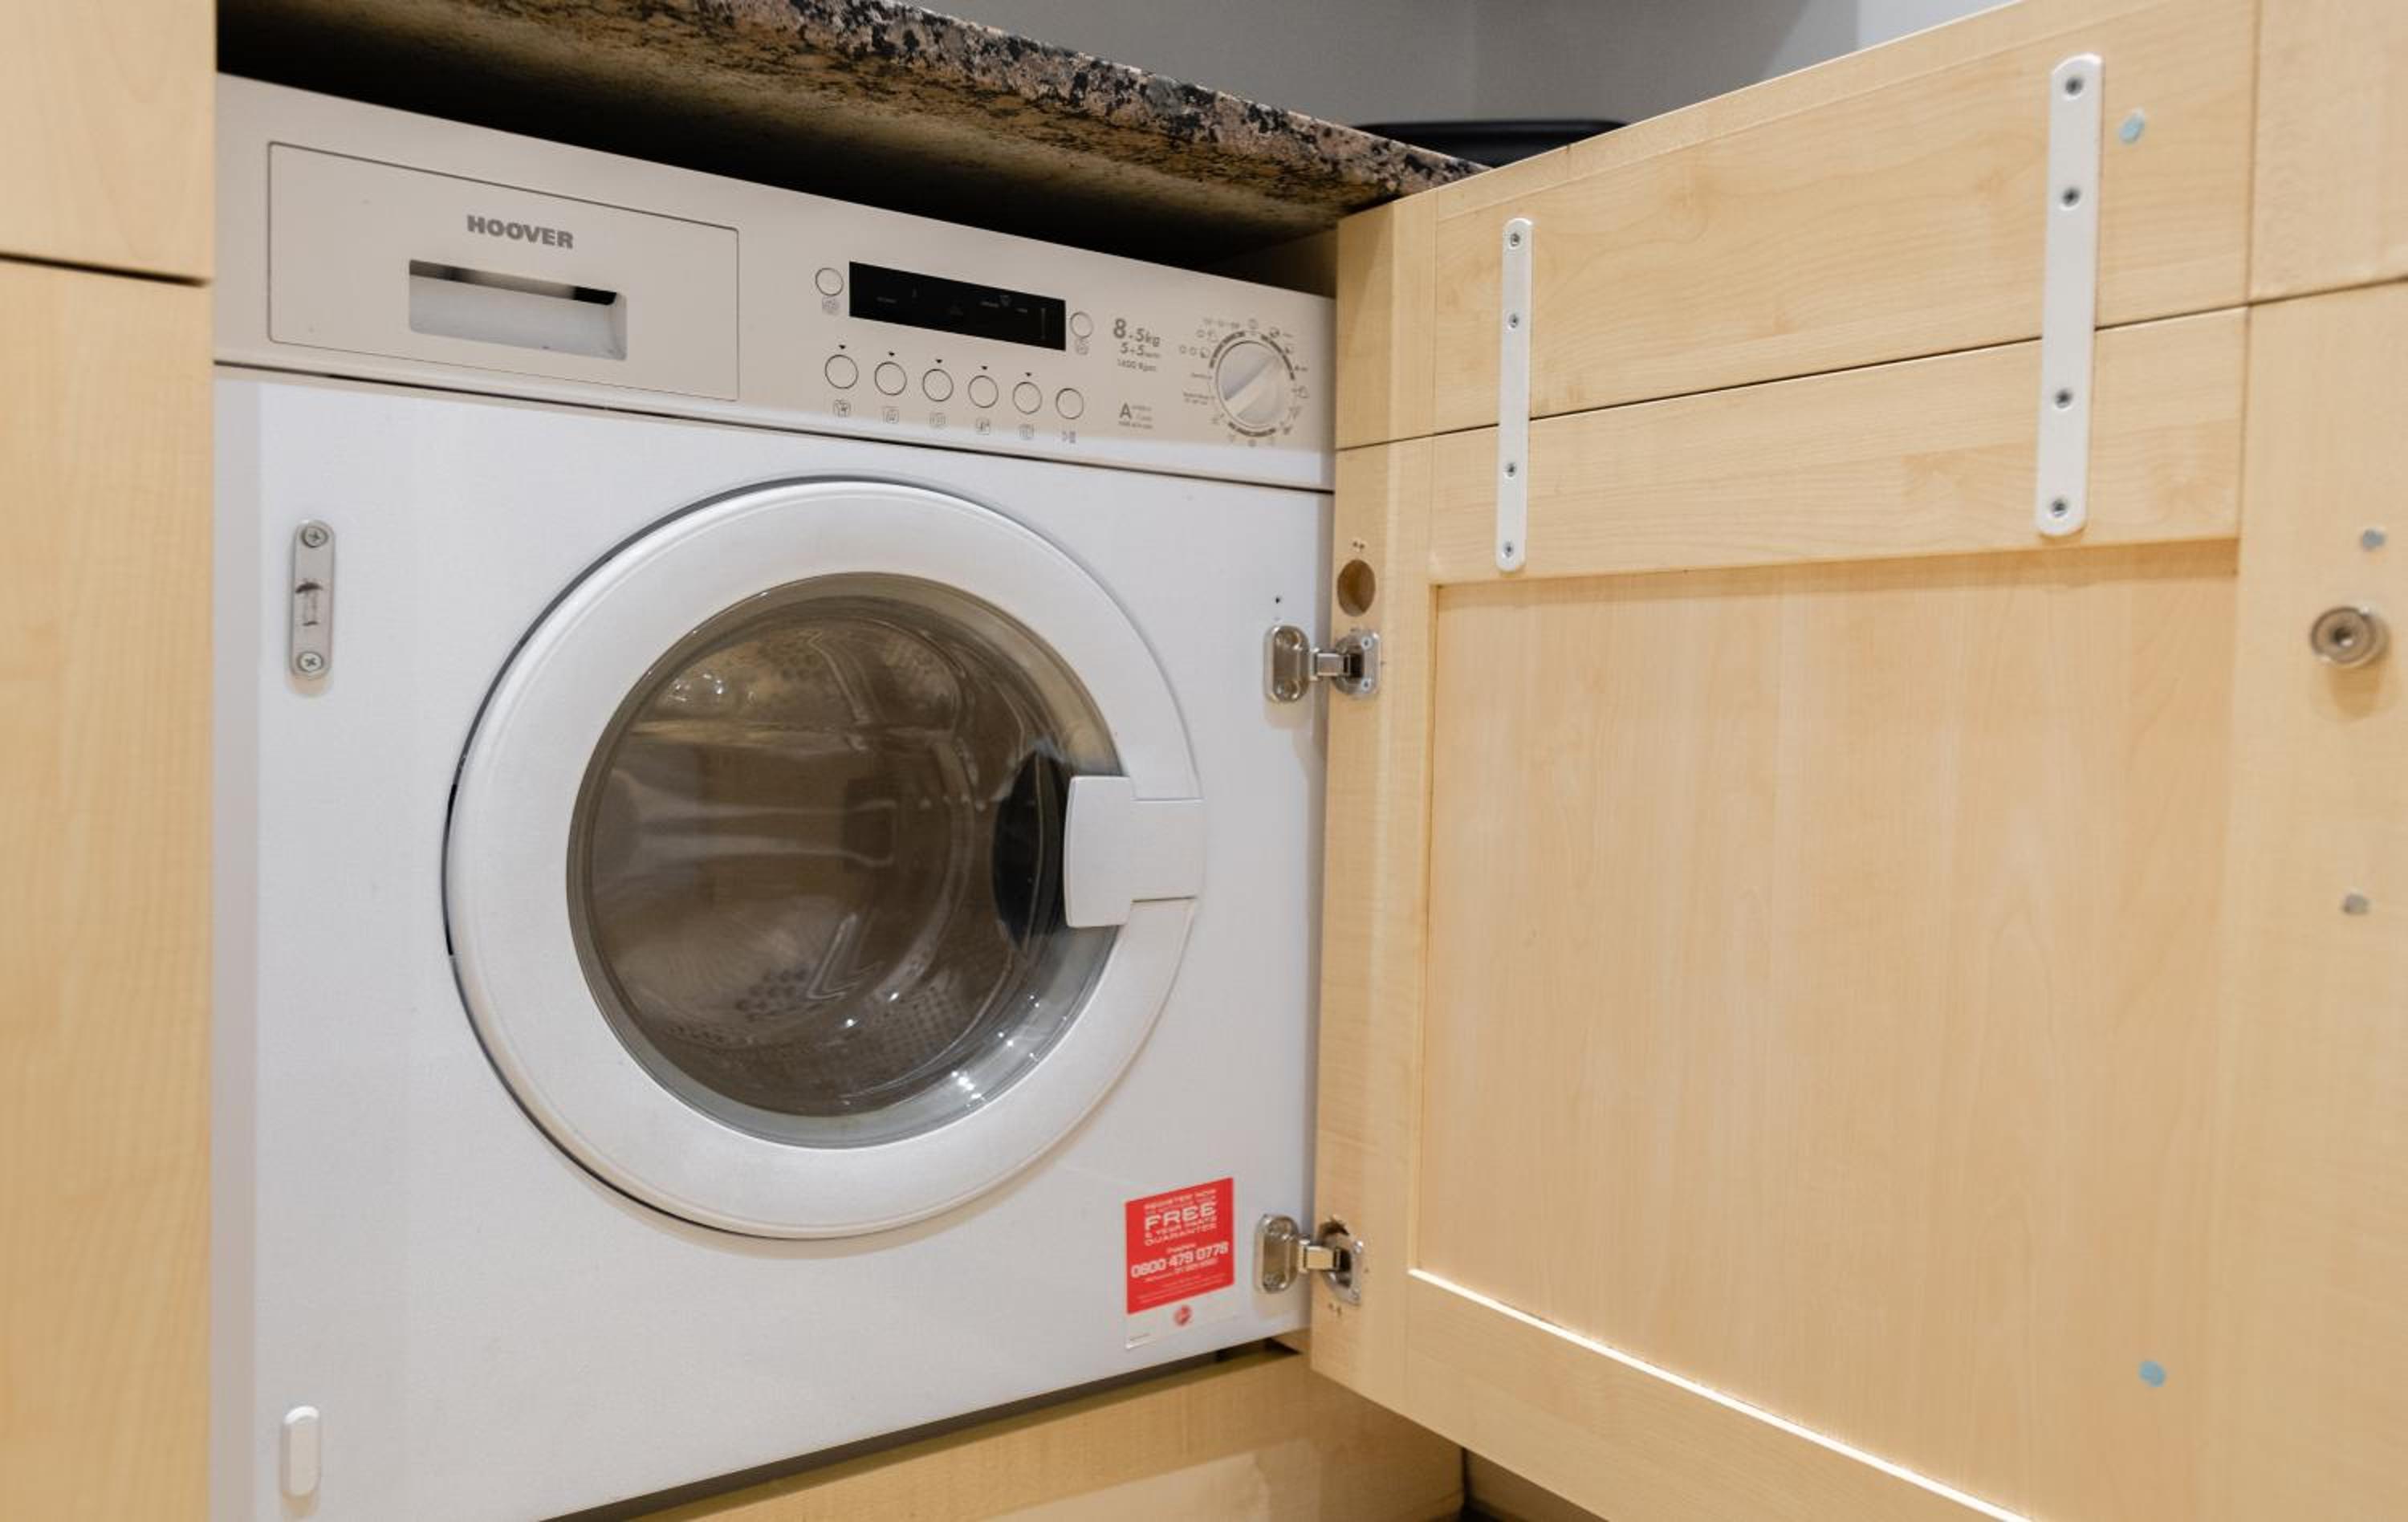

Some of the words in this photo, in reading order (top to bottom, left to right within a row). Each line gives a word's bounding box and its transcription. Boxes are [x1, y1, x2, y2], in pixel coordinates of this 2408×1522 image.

[467, 214, 573, 249] HOOVER
[1119, 403, 1132, 419] A
[1145, 1201, 1218, 1231] FREE
[1144, 1222, 1217, 1247] GUARANTEE
[1131, 1257, 1166, 1278] 0800
[1168, 1250, 1194, 1268] 479
